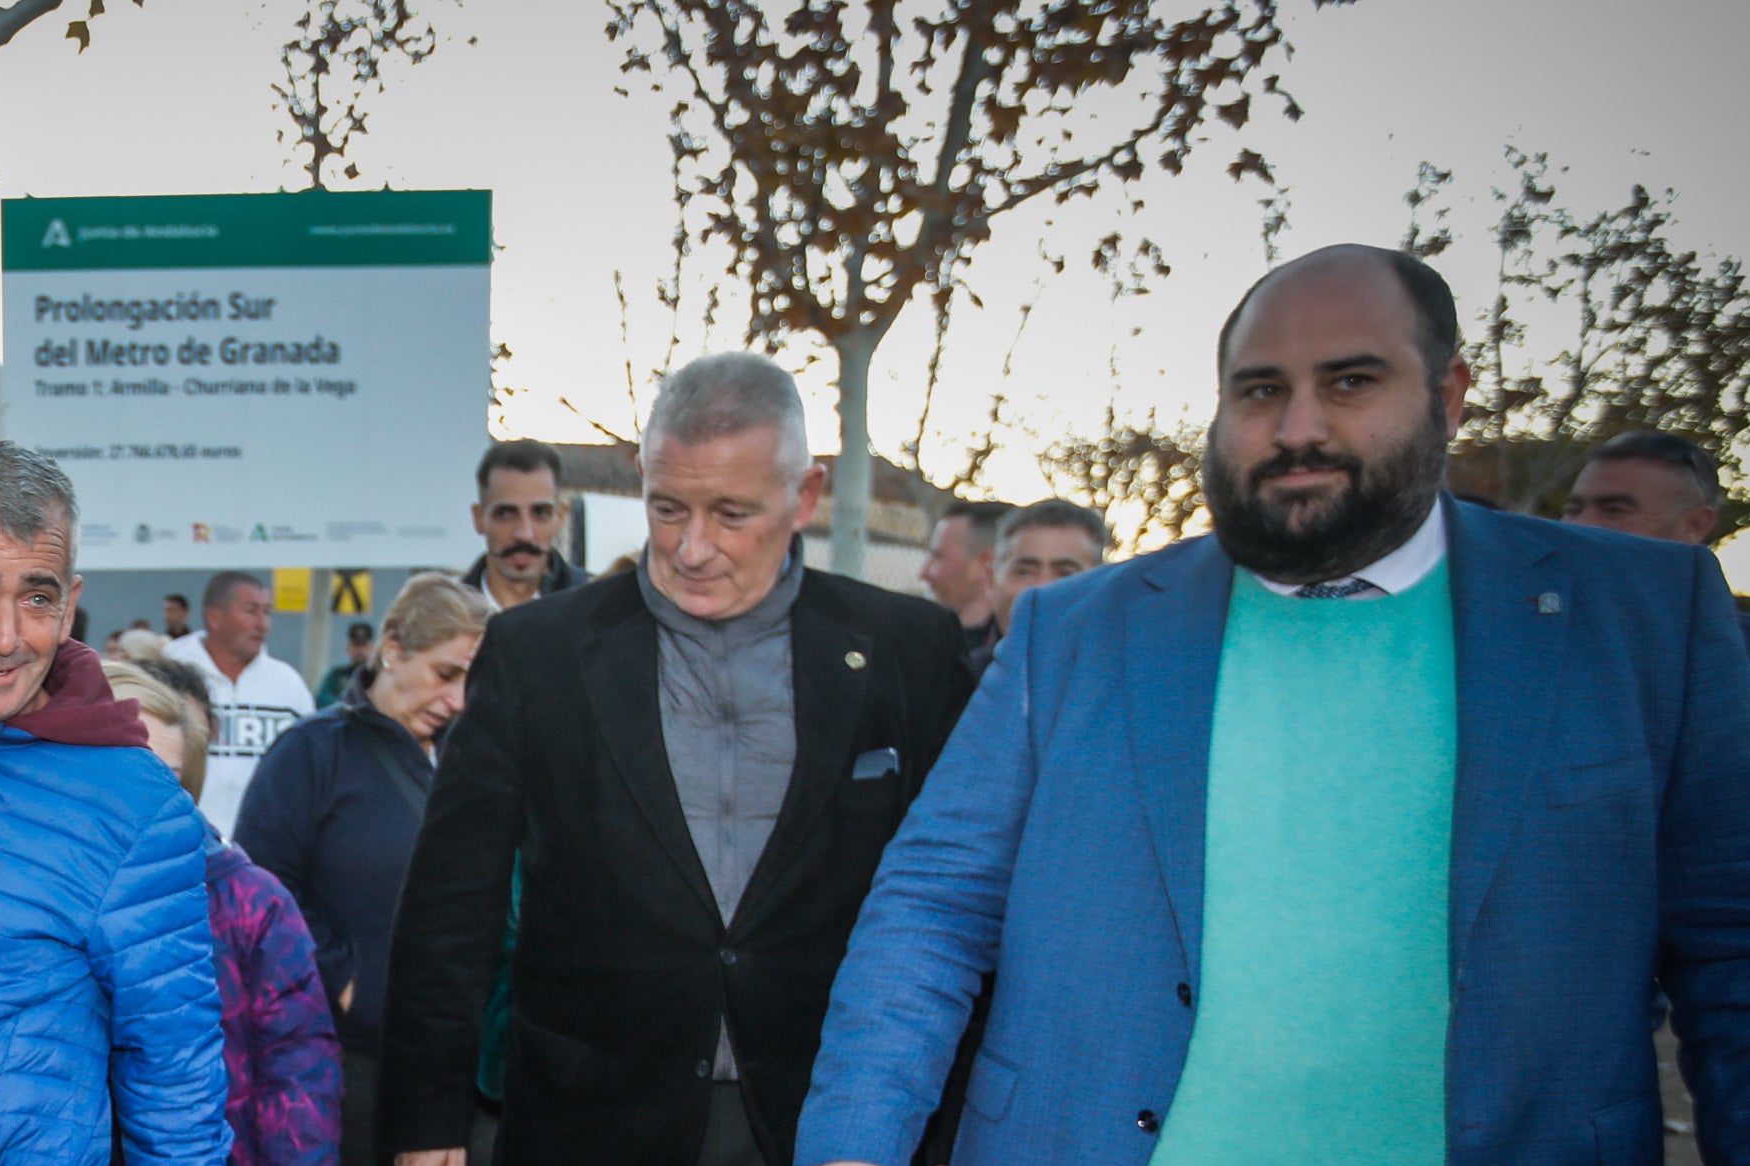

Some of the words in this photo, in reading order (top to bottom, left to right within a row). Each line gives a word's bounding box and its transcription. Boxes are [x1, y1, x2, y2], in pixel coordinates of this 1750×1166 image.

[34, 291, 221, 330] Prolongación
[227, 291, 276, 321] Sur
[34, 337, 78, 367] del
[85, 338, 171, 367] Metro
[176, 336, 212, 366] de
[219, 335, 342, 365] Granada
[34, 379, 86, 397] Tramo
[110, 377, 169, 396] Armilla
[181, 377, 266, 396] Churriana
[271, 377, 291, 394] de
[295, 377, 310, 394] la
[314, 378, 356, 400] Vega
